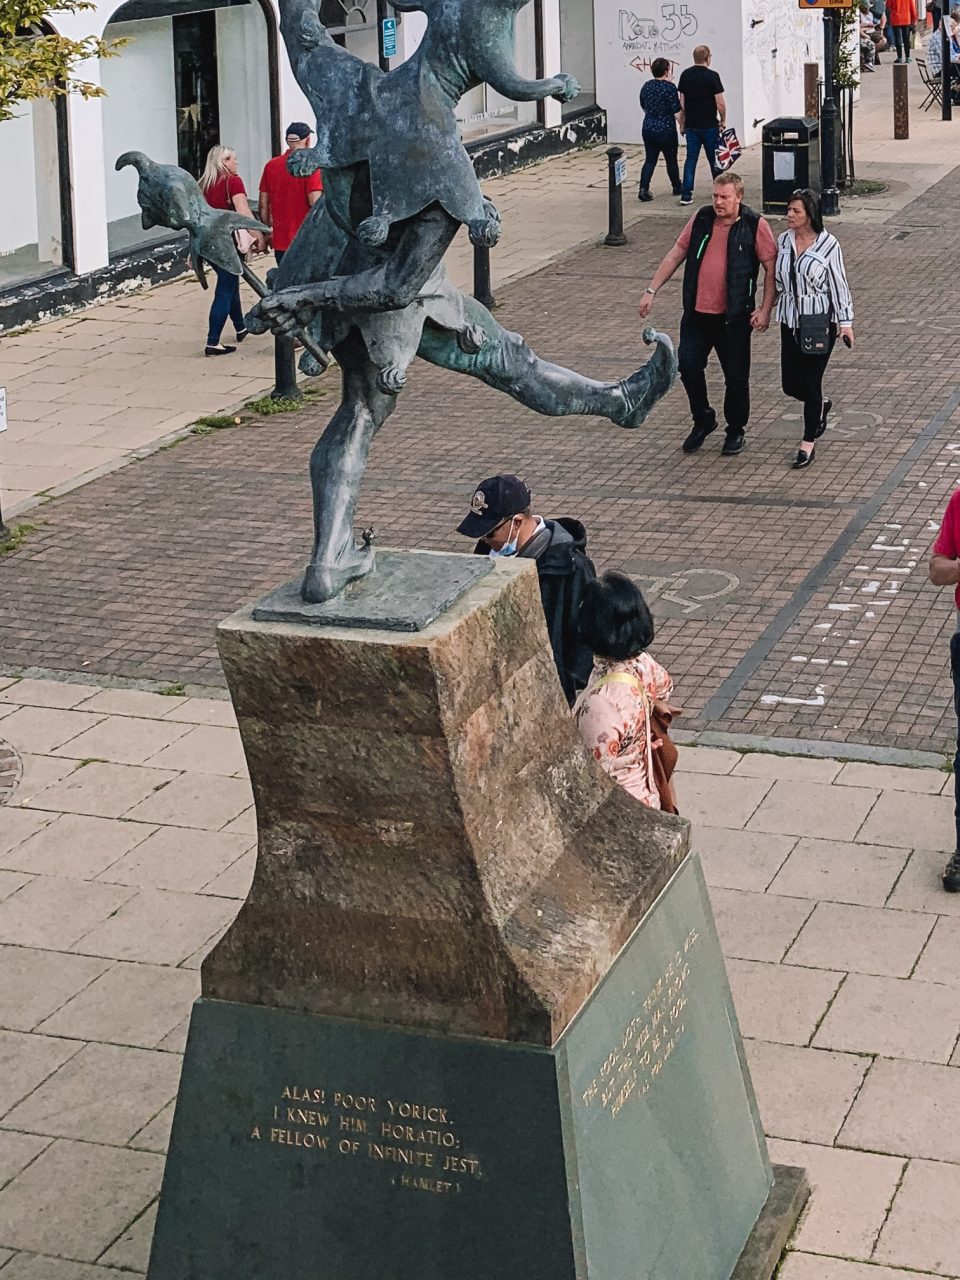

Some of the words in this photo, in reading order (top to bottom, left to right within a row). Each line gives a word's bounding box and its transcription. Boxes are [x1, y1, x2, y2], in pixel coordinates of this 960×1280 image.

[281, 1086, 325, 1104] ALAS!
[334, 1092, 376, 1112] POOR
[274, 1106, 277, 1119] I
[287, 1107, 330, 1126] KNEW
[250, 1126, 261, 1139] A
[271, 1128, 329, 1150] FELLOW
[339, 1140, 360, 1155] OF
[368, 1143, 433, 1167] INFINITE
